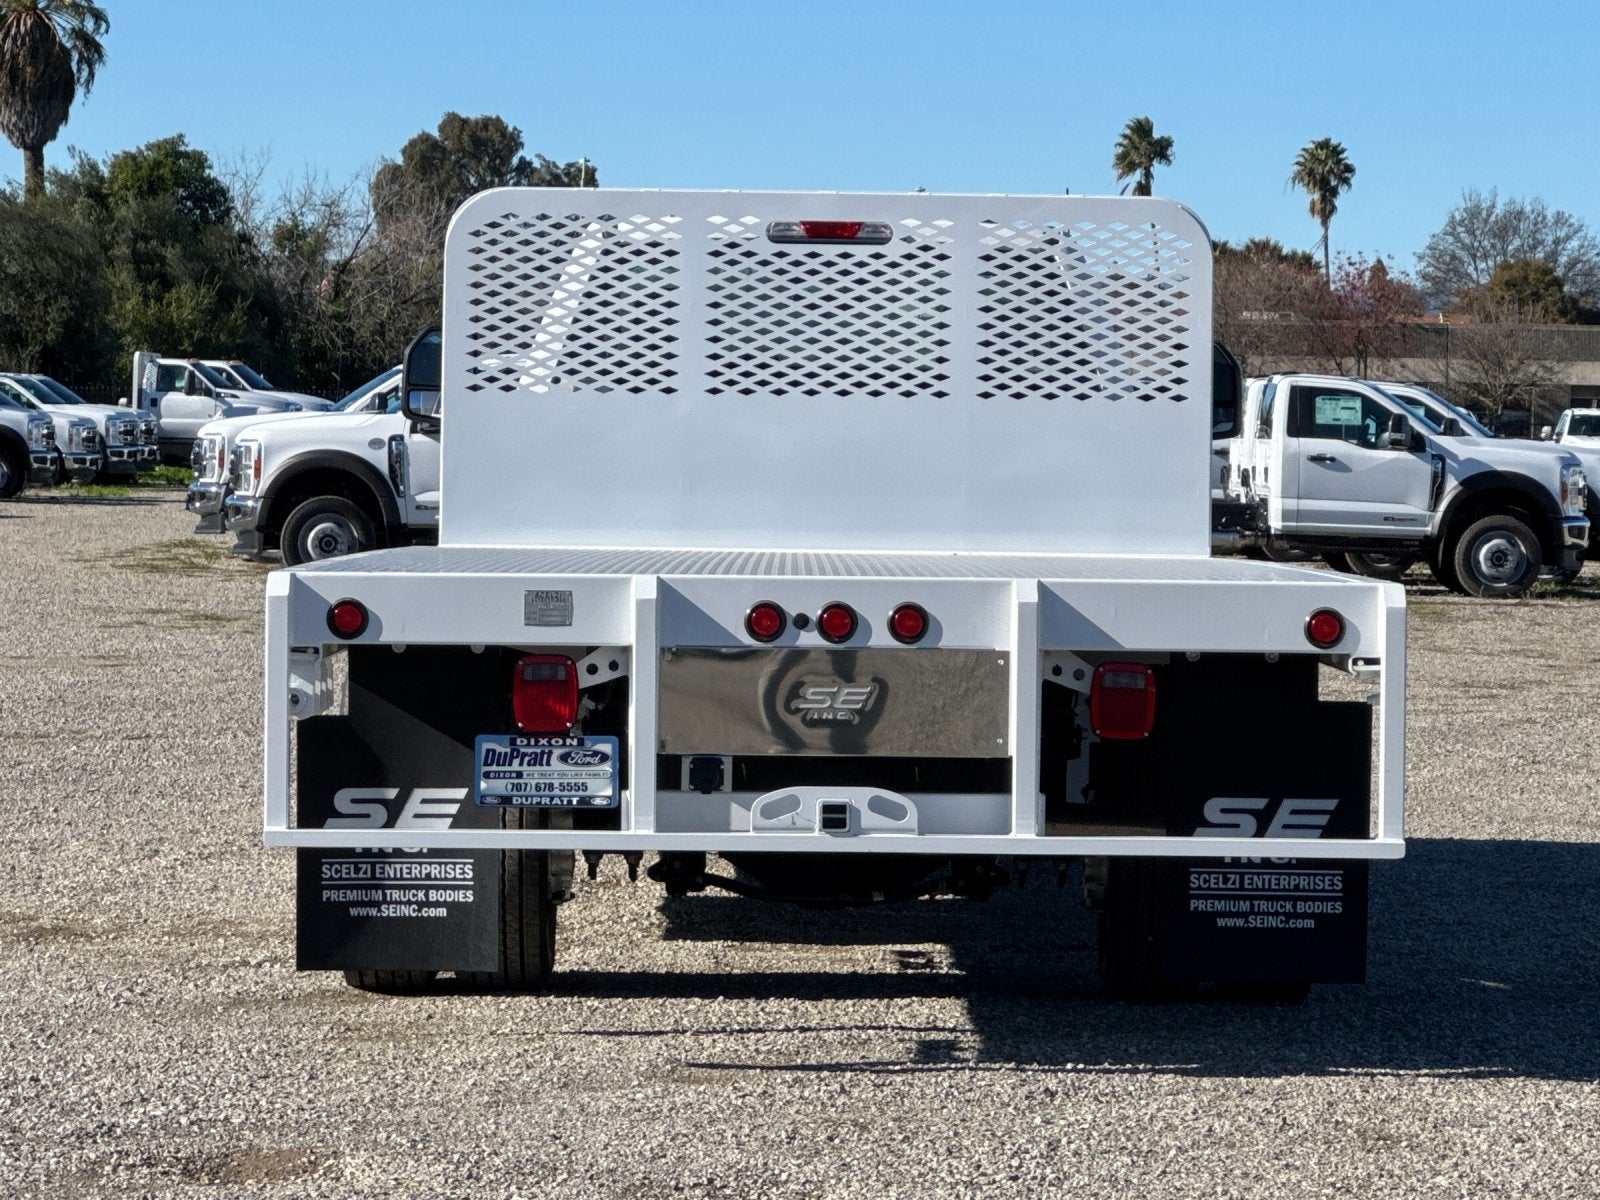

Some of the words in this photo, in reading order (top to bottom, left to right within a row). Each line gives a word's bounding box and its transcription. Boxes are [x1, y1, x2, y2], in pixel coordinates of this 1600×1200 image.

[797, 686, 872, 709] SE
[515, 737, 579, 746] DIXON
[482, 748, 554, 767] DuPratt
[567, 750, 602, 764] Ford
[505, 781, 533, 793] (707)
[534, 781, 589, 793] 678-5555
[323, 787, 469, 829] SE
[511, 797, 580, 805] DUPRATT
[1191, 797, 1340, 839] SE
[321, 864, 371, 879] SCELZI
[375, 864, 474, 879] ENTERPRISES
[1189, 873, 1240, 889] SCELZI
[1244, 874, 1343, 890] ENTERPRISES
[322, 889, 383, 902] PREMIUM
[385, 889, 426, 902] TRUCK
[428, 889, 474, 902] BODIES
[349, 904, 447, 917] www.SEINC.com
[1189, 899, 1250, 912] PREMIUM
[1252, 901, 1294, 913] TRUCK
[1296, 902, 1343, 914] BODIES
[1216, 916, 1315, 929] www.SEINC.com
